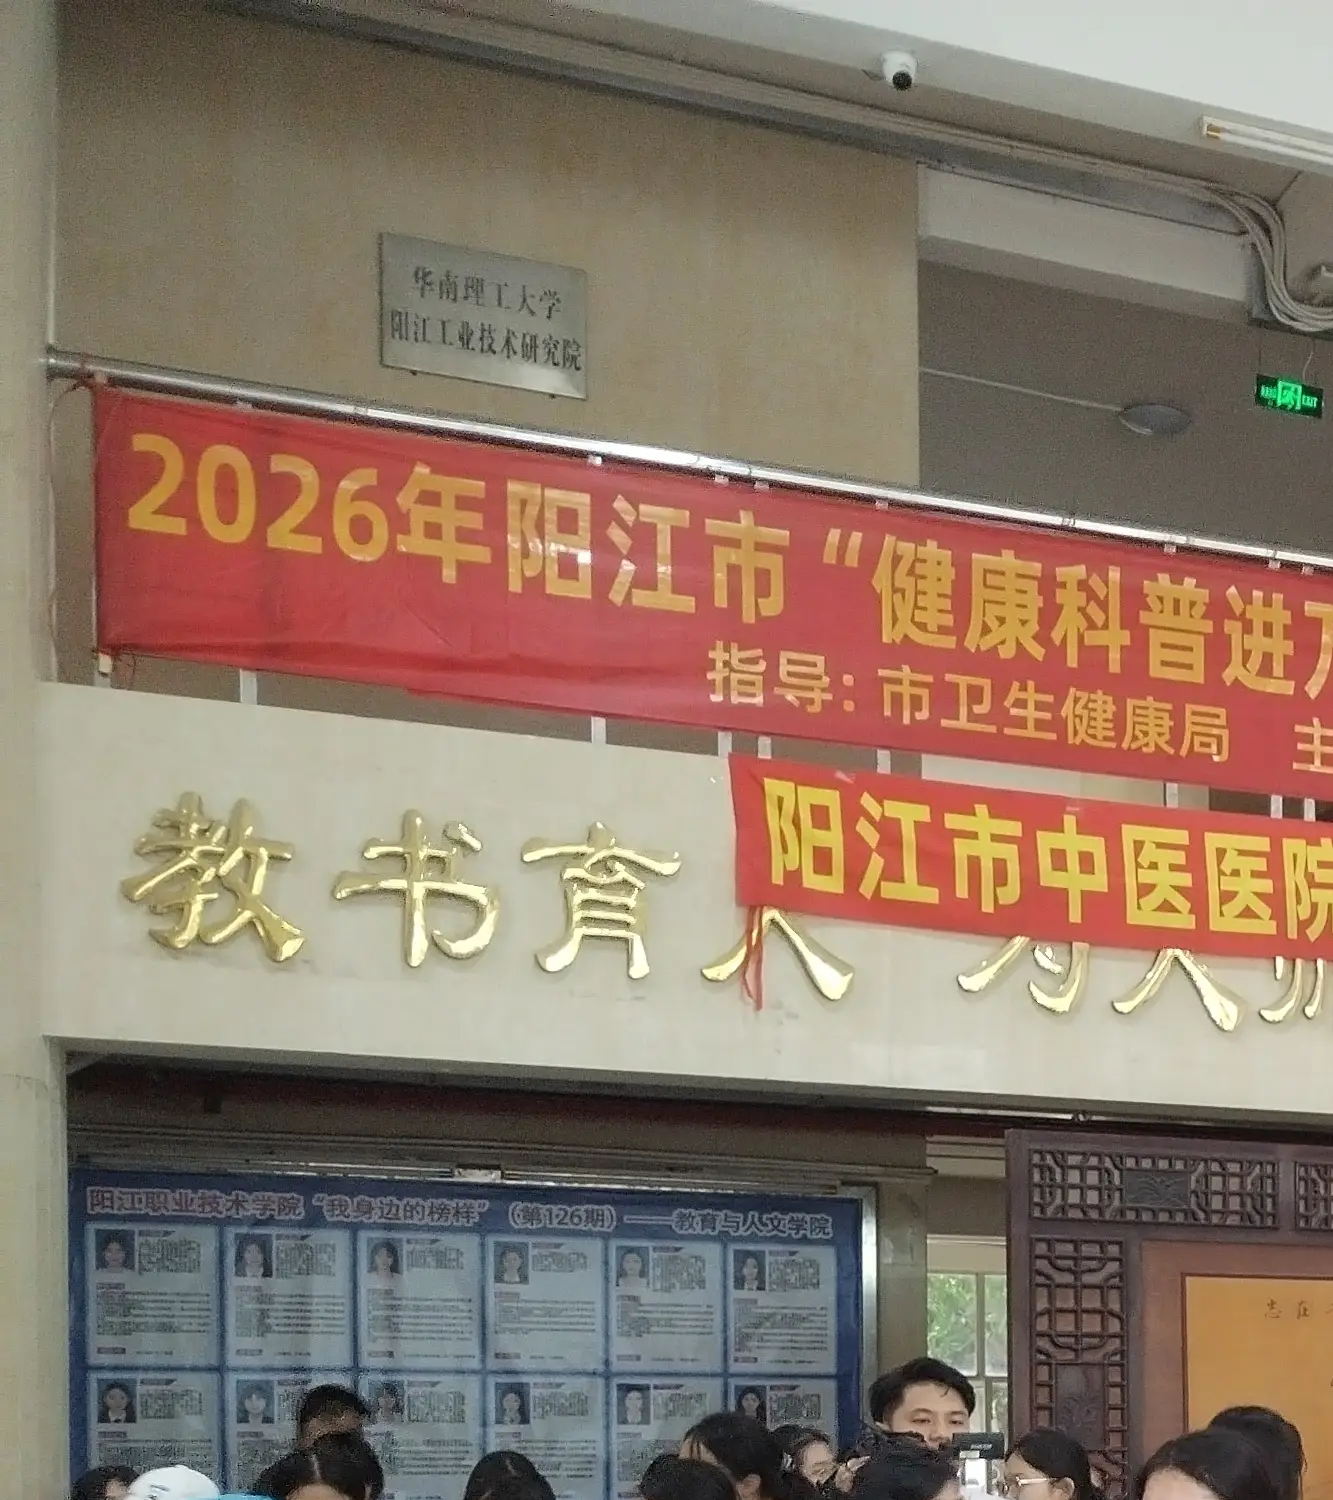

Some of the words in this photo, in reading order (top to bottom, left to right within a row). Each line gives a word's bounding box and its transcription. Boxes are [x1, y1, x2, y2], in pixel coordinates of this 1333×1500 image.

[413, 265, 562, 320] 华南理工大学
[390, 309, 582, 371] 阳江工业技术研究院
